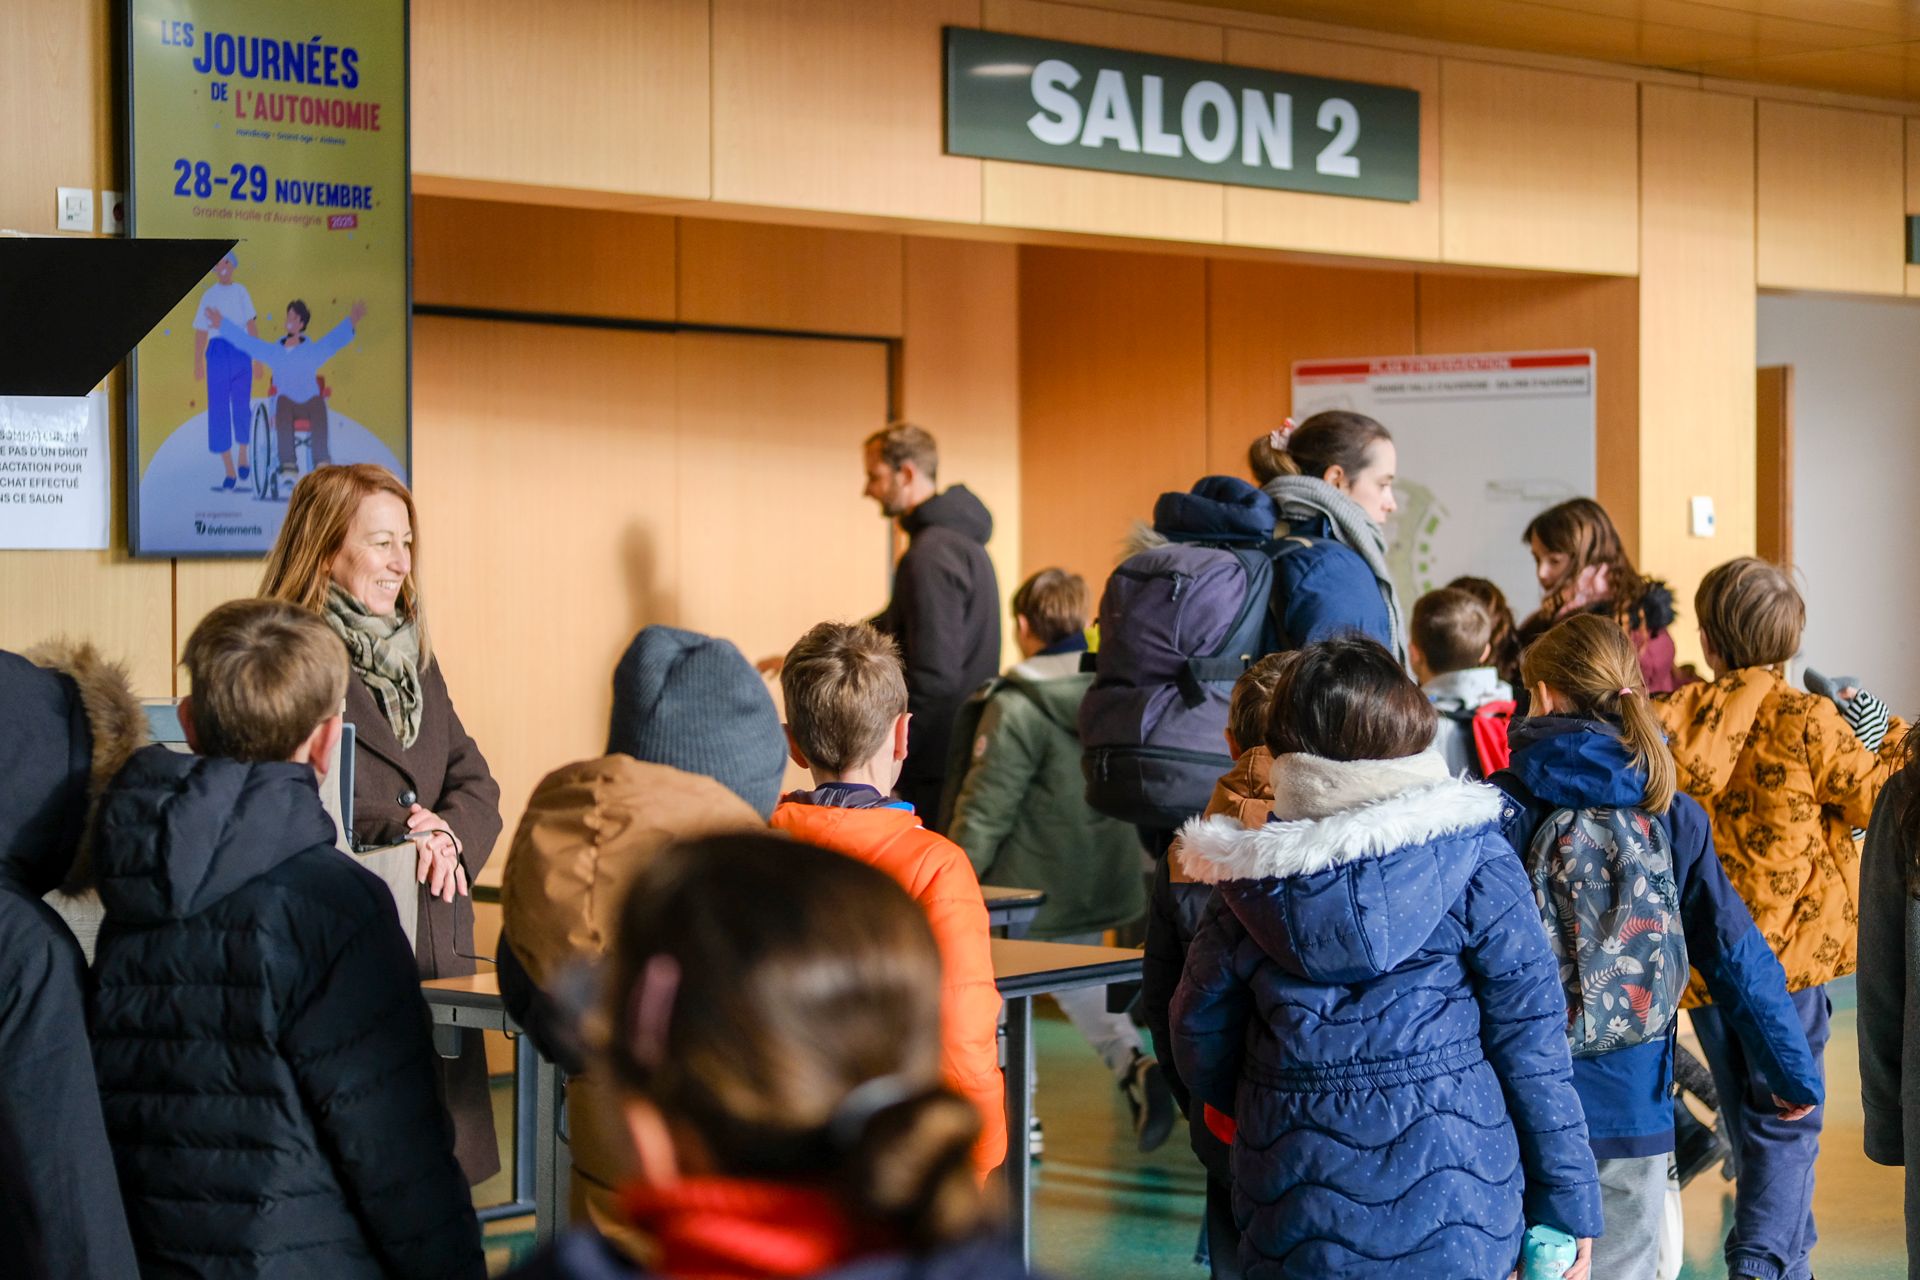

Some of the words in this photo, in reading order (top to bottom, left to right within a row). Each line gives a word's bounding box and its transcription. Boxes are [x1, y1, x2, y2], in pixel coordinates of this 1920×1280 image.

[161, 20, 194, 47] LES
[193, 32, 359, 89] JOURNÉES
[211, 82, 228, 102] DE
[236, 90, 381, 131] L'AUTONOMIE
[1027, 59, 1292, 169] SALON
[1316, 98, 1360, 178] 2
[174, 158, 267, 203] 28-29
[276, 180, 372, 210] NOVEMBRE
[193, 206, 232, 219] Grande
[235, 210, 261, 221] Halle
[264, 211, 322, 229] d'Auvergne
[9, 446, 28, 457] PAS
[30, 447, 56, 457] D'UN
[58, 447, 88, 457] DROIT
[54, 463, 82, 473] POUR
[29, 477, 79, 488] EFFECTUÉ
[13, 493, 27, 503] CE
[29, 493, 63, 504] SALON
